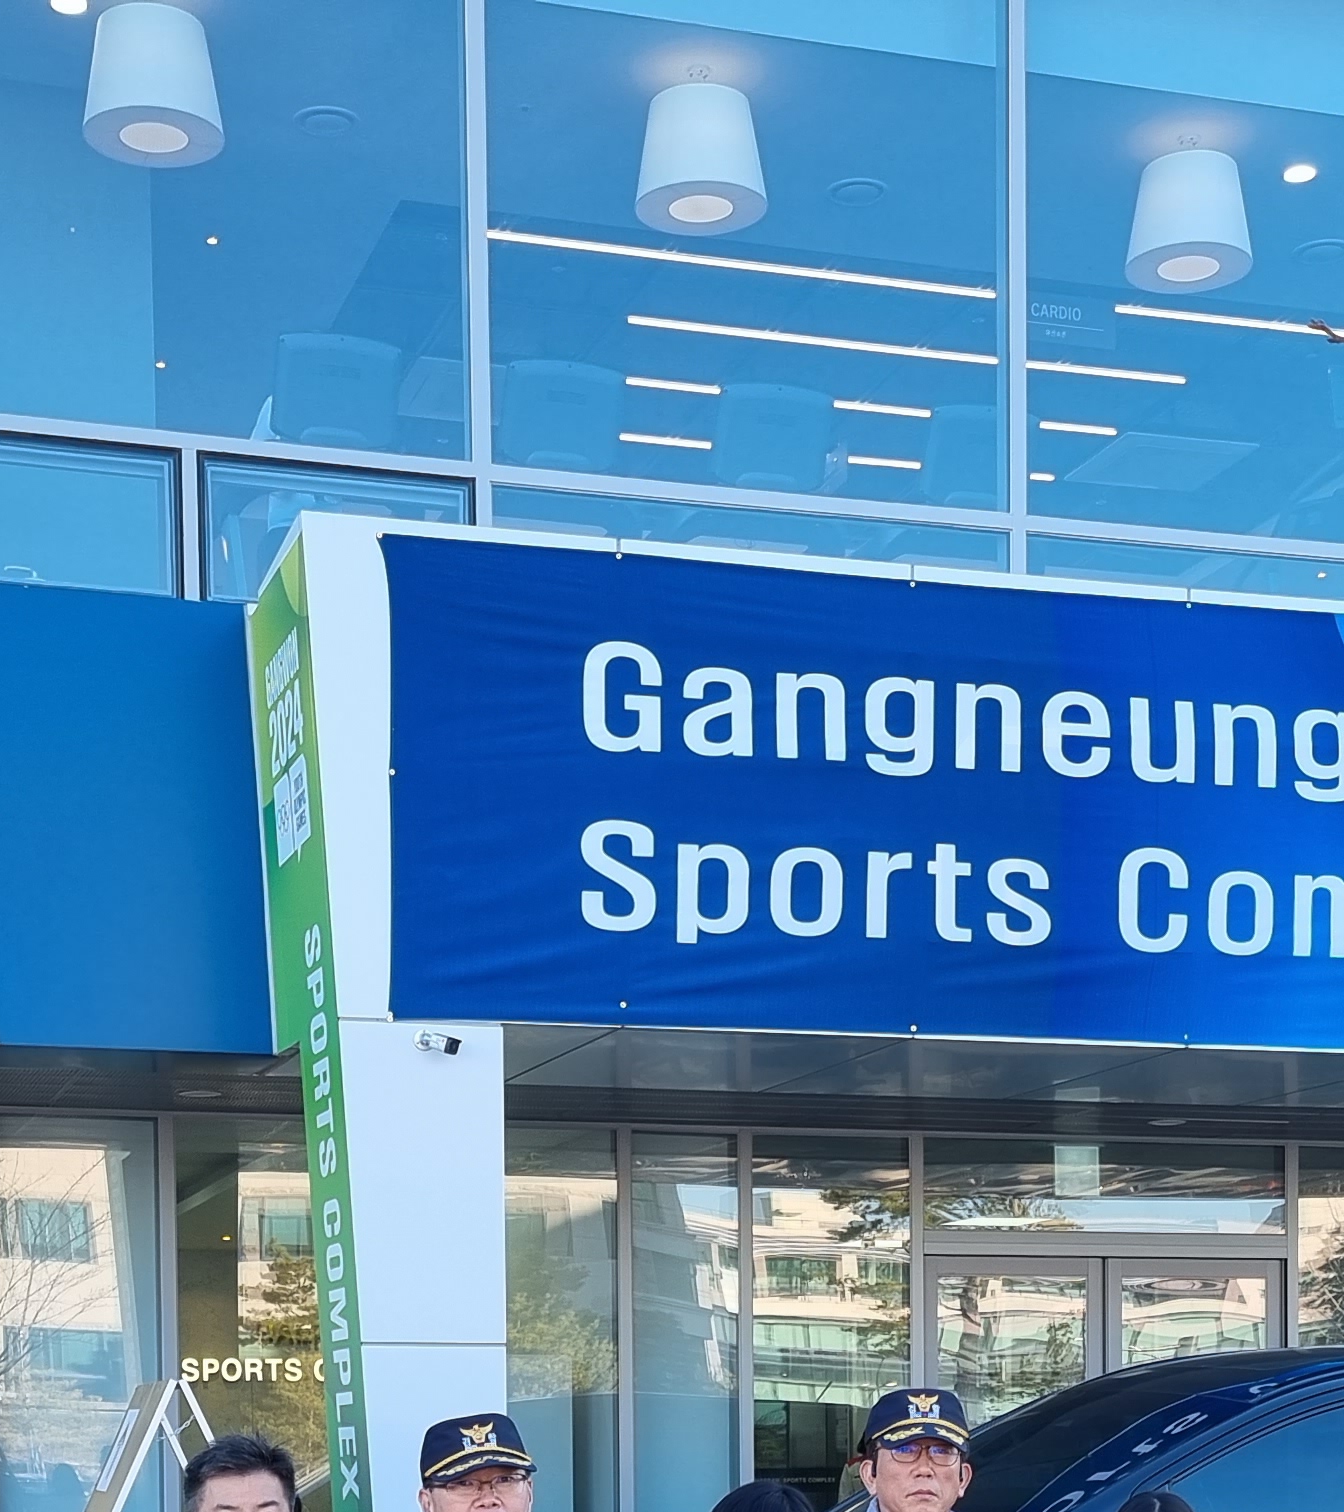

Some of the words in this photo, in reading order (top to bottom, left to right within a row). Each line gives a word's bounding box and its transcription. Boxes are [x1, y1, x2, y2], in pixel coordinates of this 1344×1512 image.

[1031, 302, 1082, 322] CARDIO
[268, 677, 304, 779] 2024
[579, 818, 1052, 945] Sports
[303, 922, 338, 1179] SPORTS
[181, 1357, 303, 1384] SPORTS
[320, 1199, 361, 1501] COMPLEX
